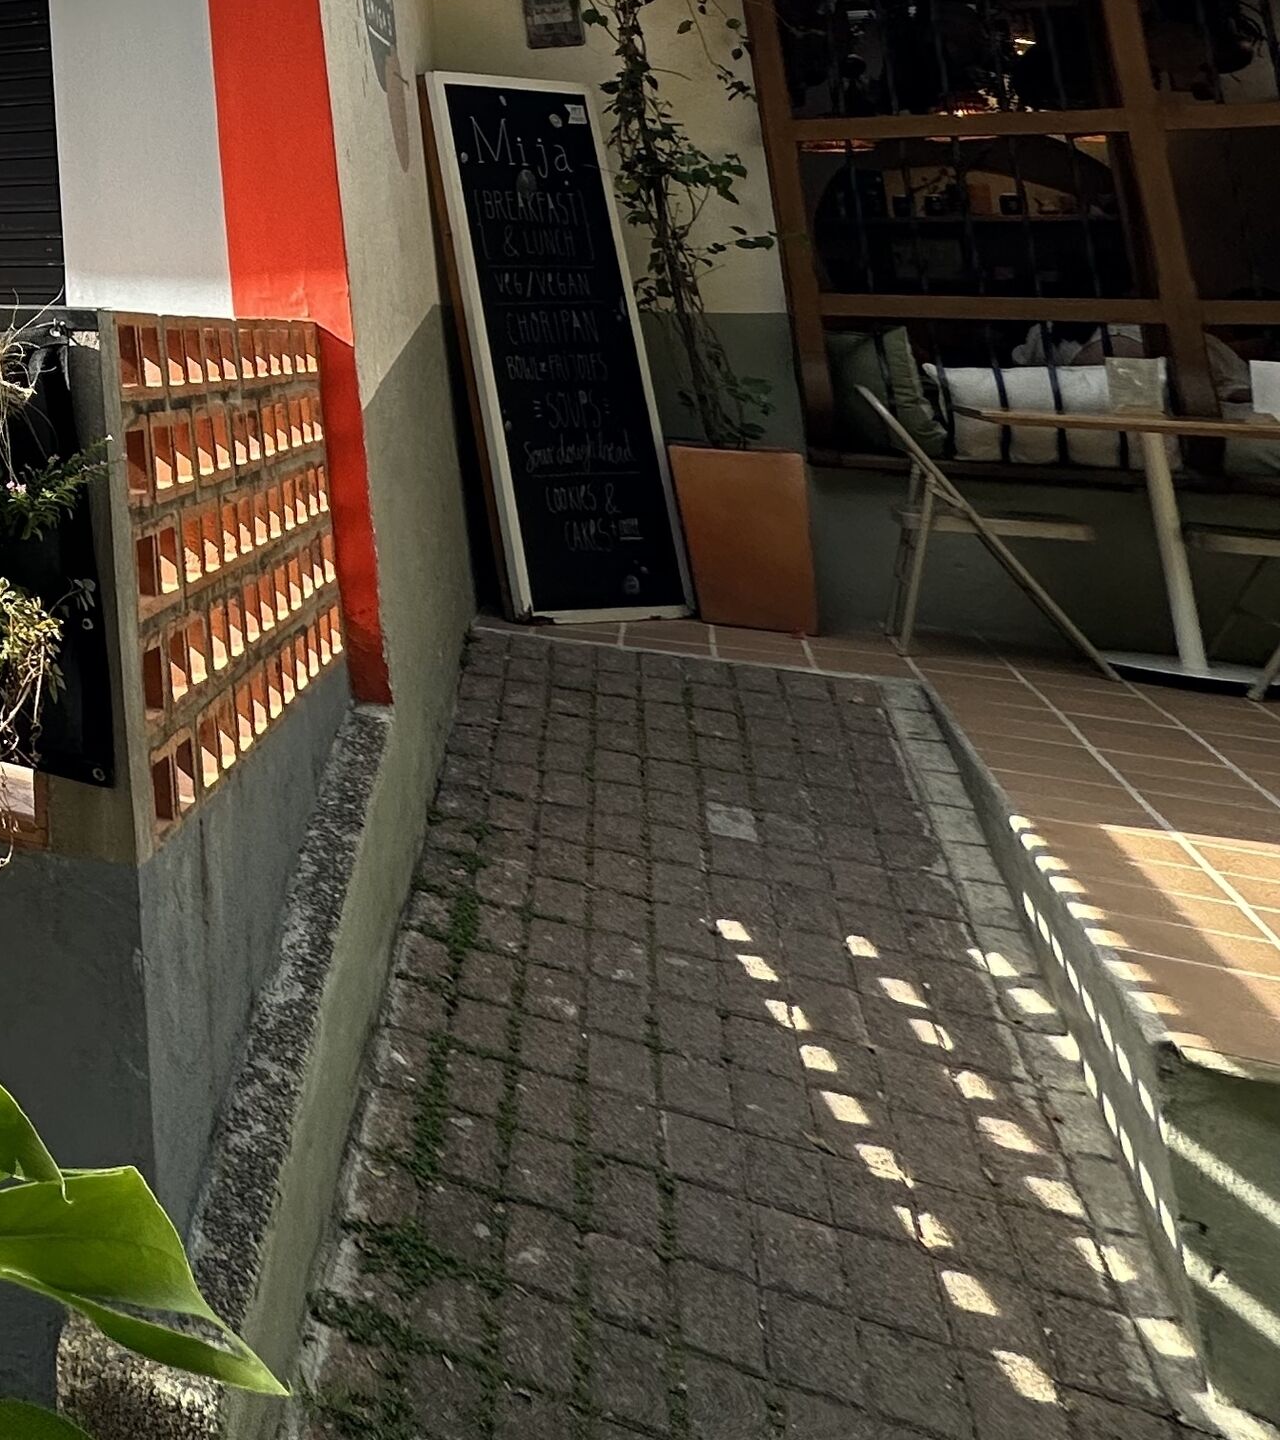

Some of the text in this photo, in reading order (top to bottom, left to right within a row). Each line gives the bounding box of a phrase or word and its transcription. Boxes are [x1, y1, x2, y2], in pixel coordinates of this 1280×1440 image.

[469, 115, 574, 179] Mija
[482, 189, 580, 227] BREAKFAST
[503, 224, 577, 257] & LUNCH
[505, 308, 600, 346] CHORIPAN
[544, 389, 602, 430] SOUPS
